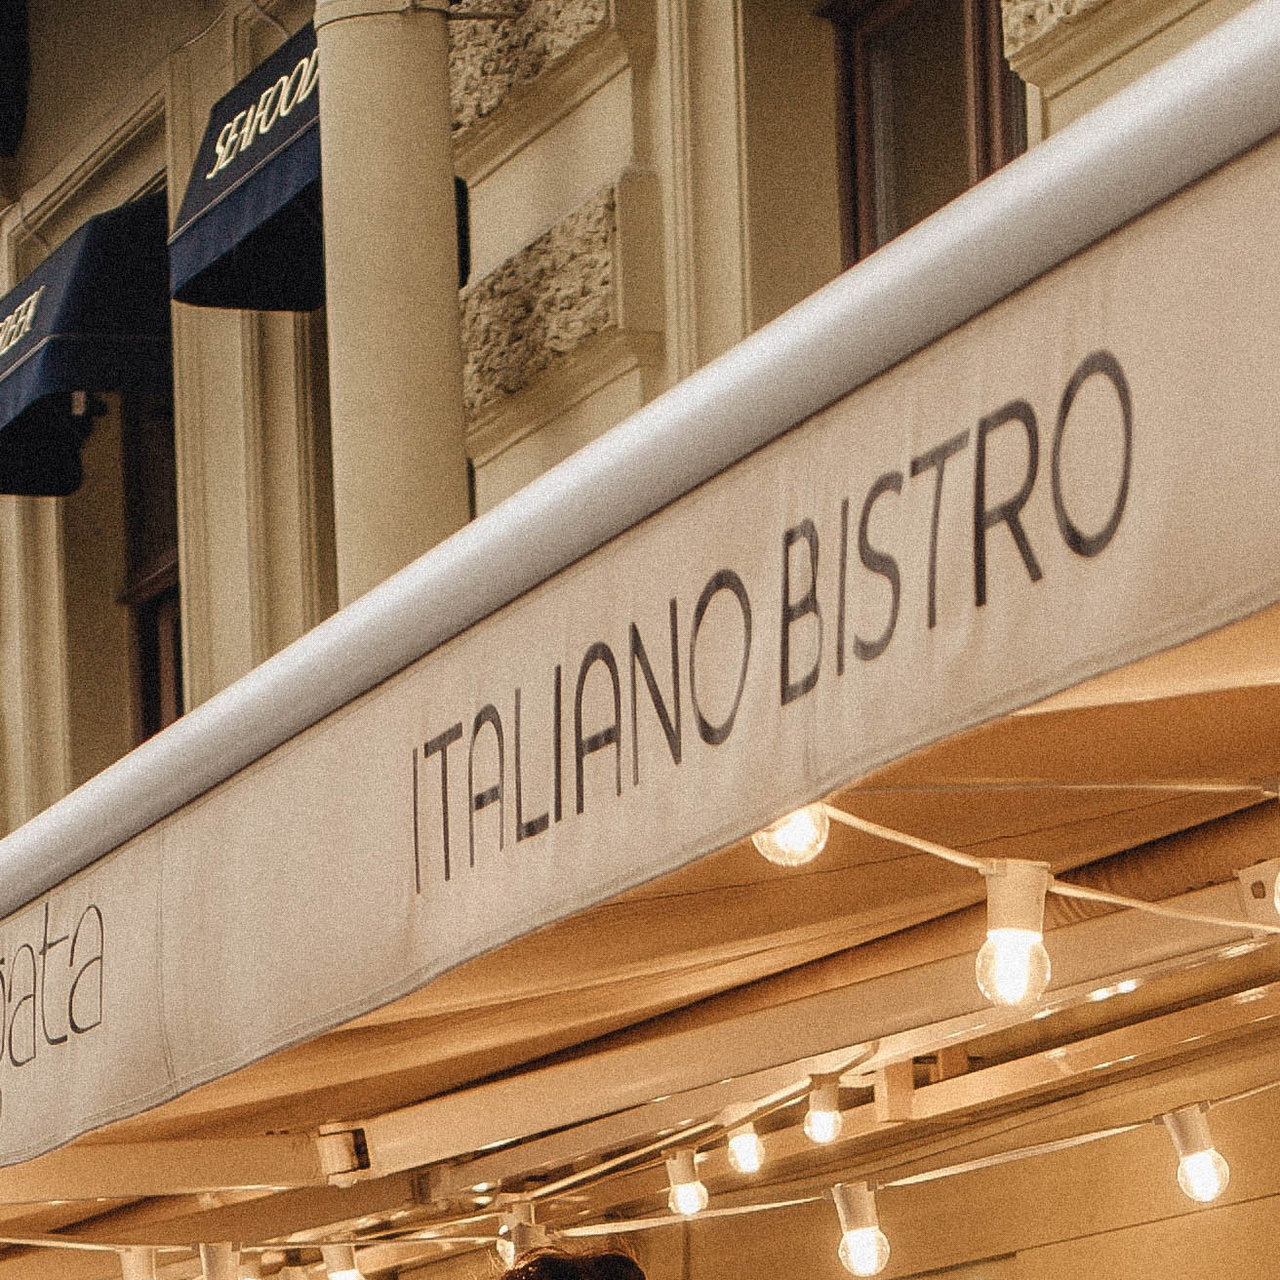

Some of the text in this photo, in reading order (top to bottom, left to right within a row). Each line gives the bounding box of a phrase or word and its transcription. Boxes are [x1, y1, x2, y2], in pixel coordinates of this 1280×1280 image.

[206, 47, 320, 180] SEAFOOD
[411, 350, 1134, 895] ITALIANO BISTRO
[0, 902, 104, 1116] ata
